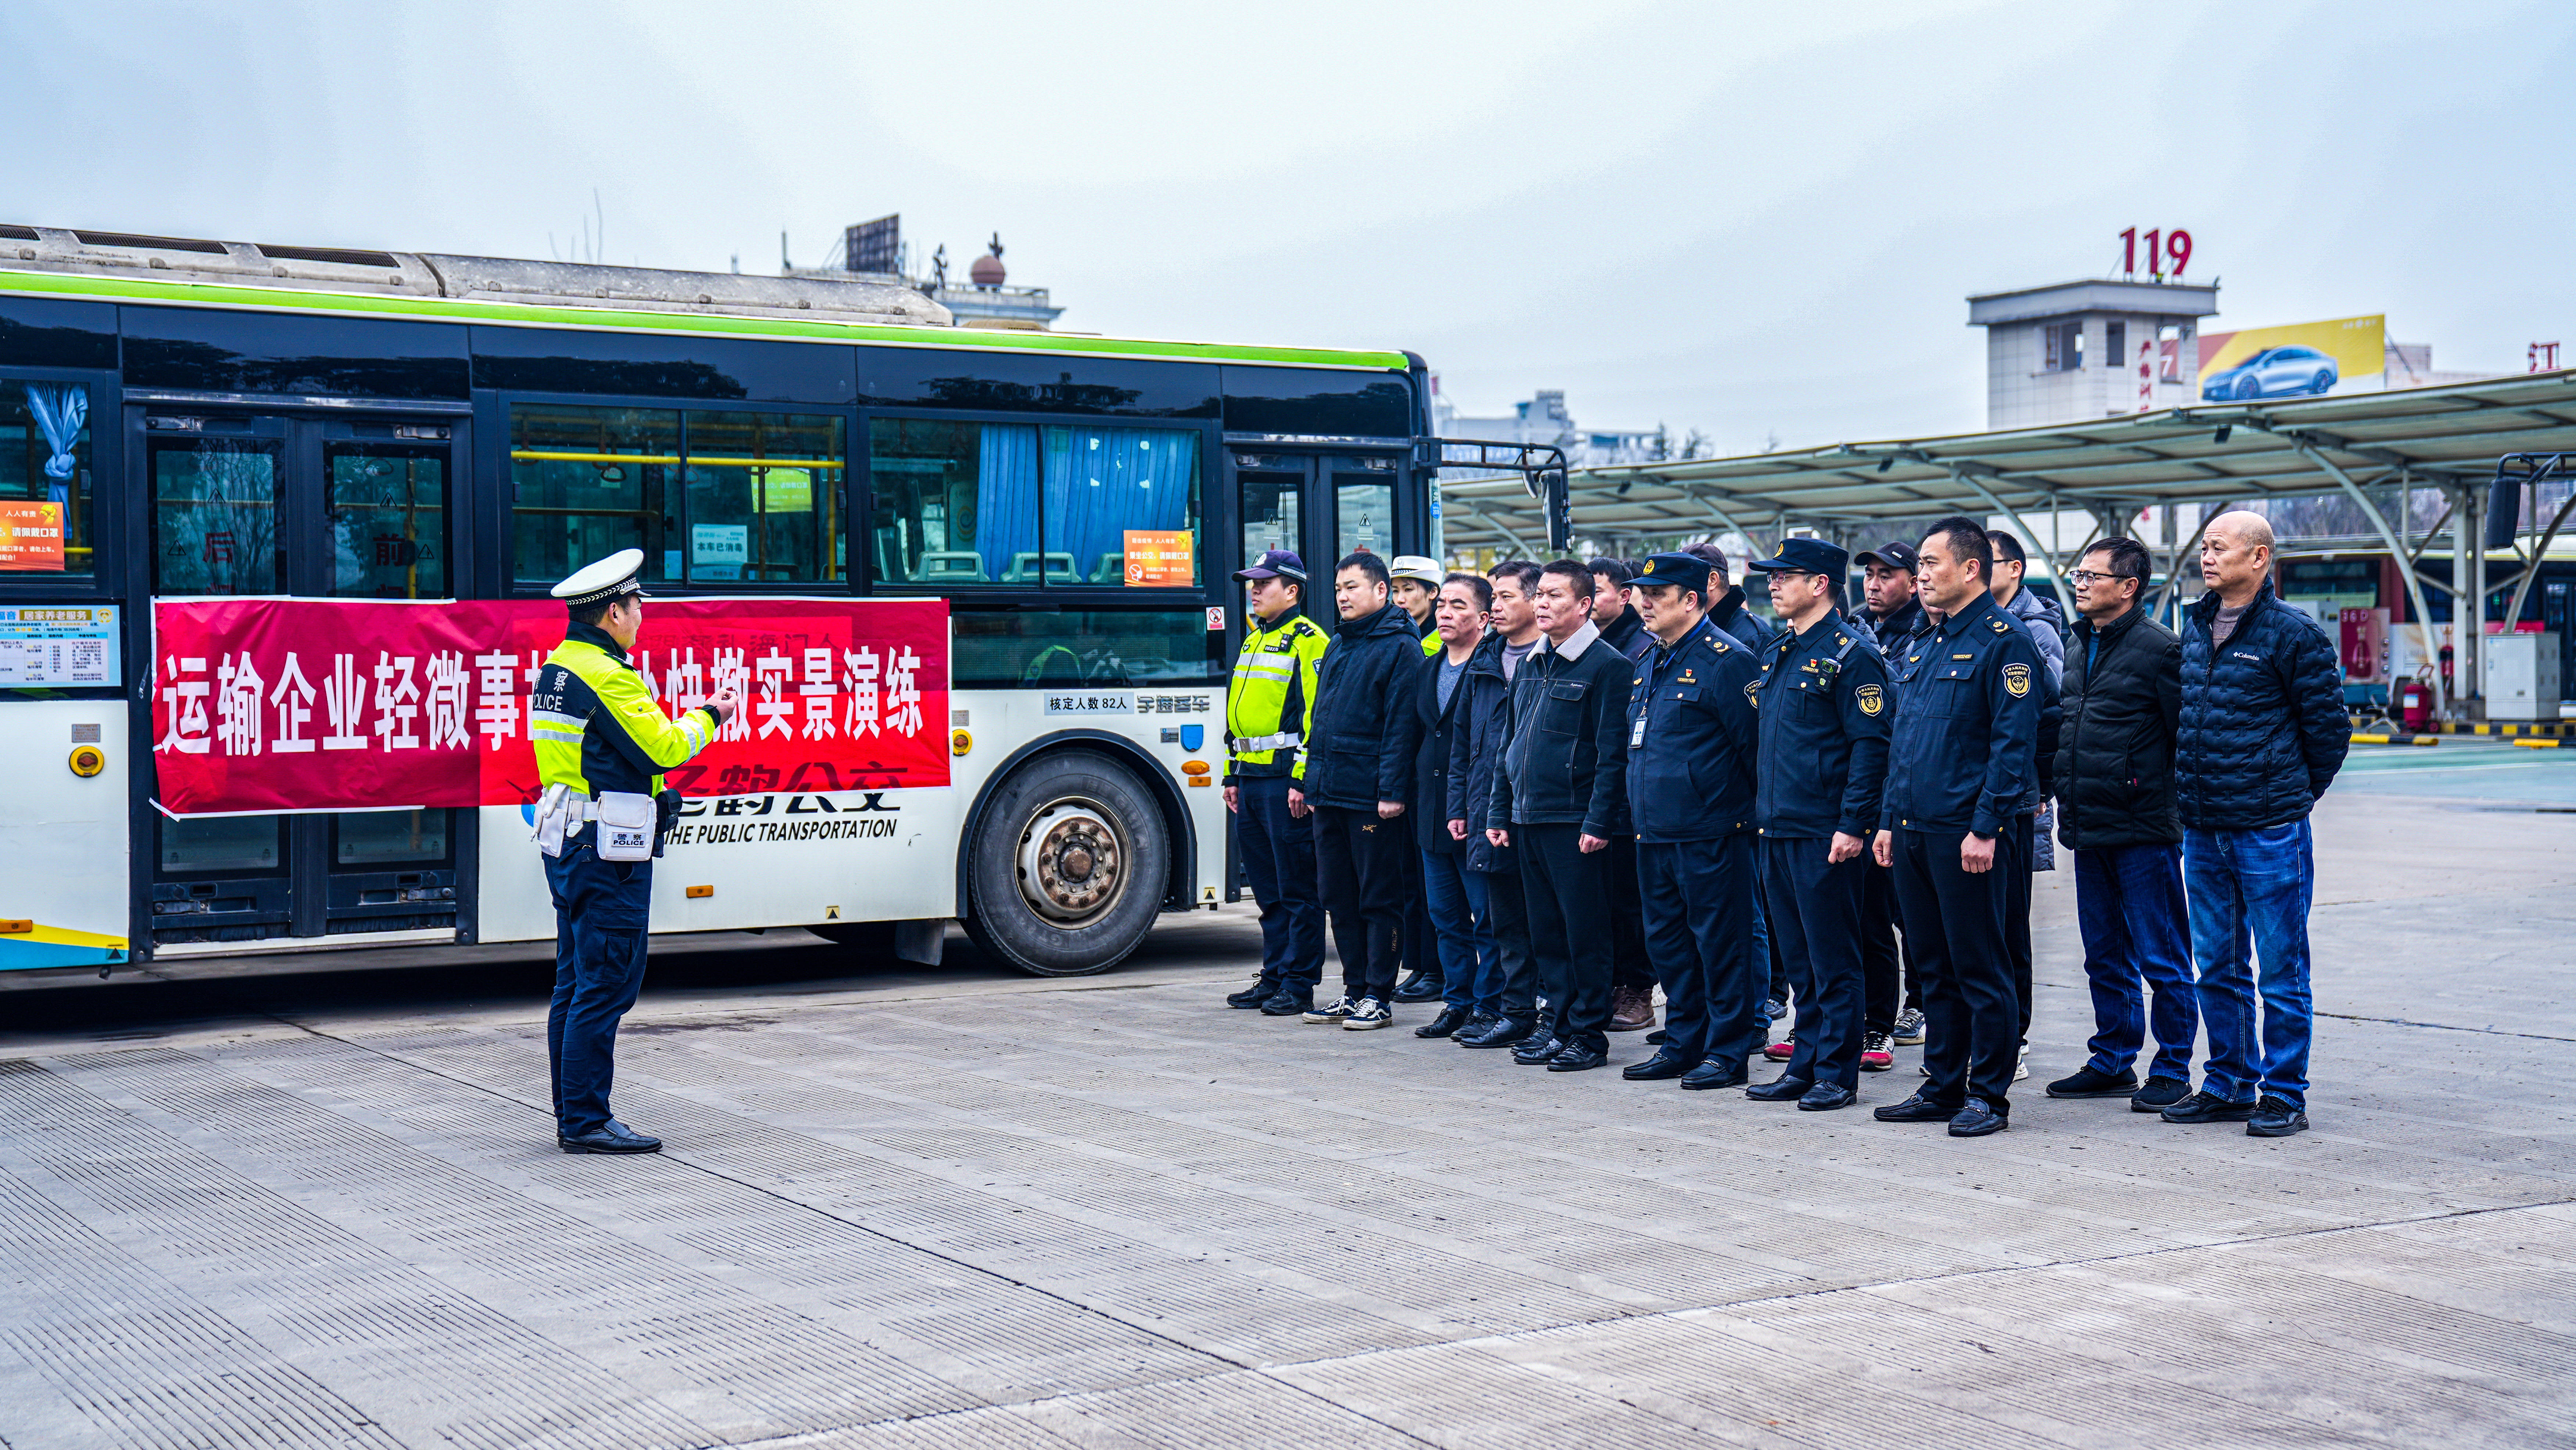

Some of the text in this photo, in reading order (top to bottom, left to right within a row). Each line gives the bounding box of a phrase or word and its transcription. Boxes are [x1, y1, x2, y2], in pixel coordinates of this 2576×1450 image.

[2120, 225, 2192, 275] 119
[697, 542, 743, 552] 本车已消毒
[24, 611, 87, 620] 居家养老服务
[2238, 652, 2260, 661] Columbia
[1049, 696, 1127, 710] 核定人数 82人
[1137, 694, 1210, 713] 宇通客车
[696, 823, 756, 844] PUBLIC
[757, 818, 897, 842] TRANSPORTATION
